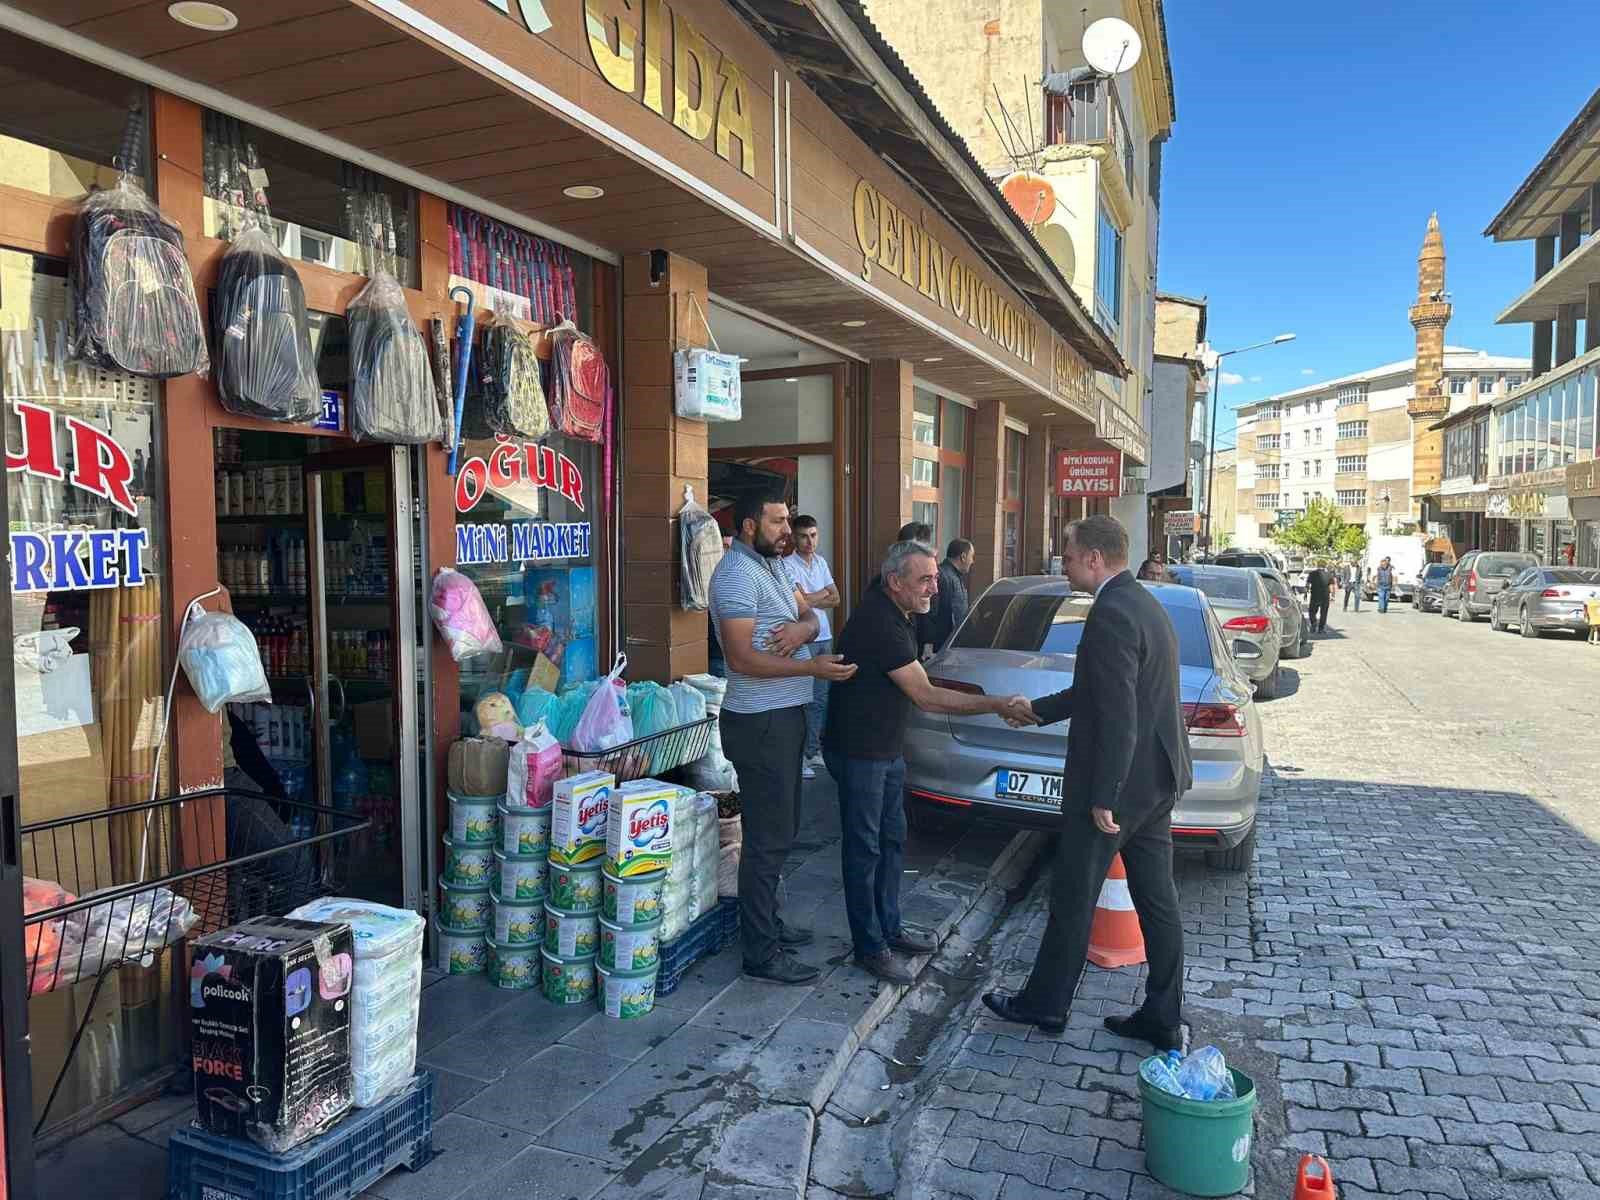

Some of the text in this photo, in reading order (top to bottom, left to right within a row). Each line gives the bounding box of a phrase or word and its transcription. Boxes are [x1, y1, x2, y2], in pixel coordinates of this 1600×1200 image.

[853, 176, 1038, 367] ÇETİN OTOMOTİV
[455, 431, 585, 513] OĞUR
[1070, 466, 1108, 476] ÜRÜNLERİ
[1084, 456, 1114, 465] KORUMA
[512, 522, 590, 561] MARKET
[1008, 773, 1029, 792] 07
[192, 1056, 243, 1081] FORCE
